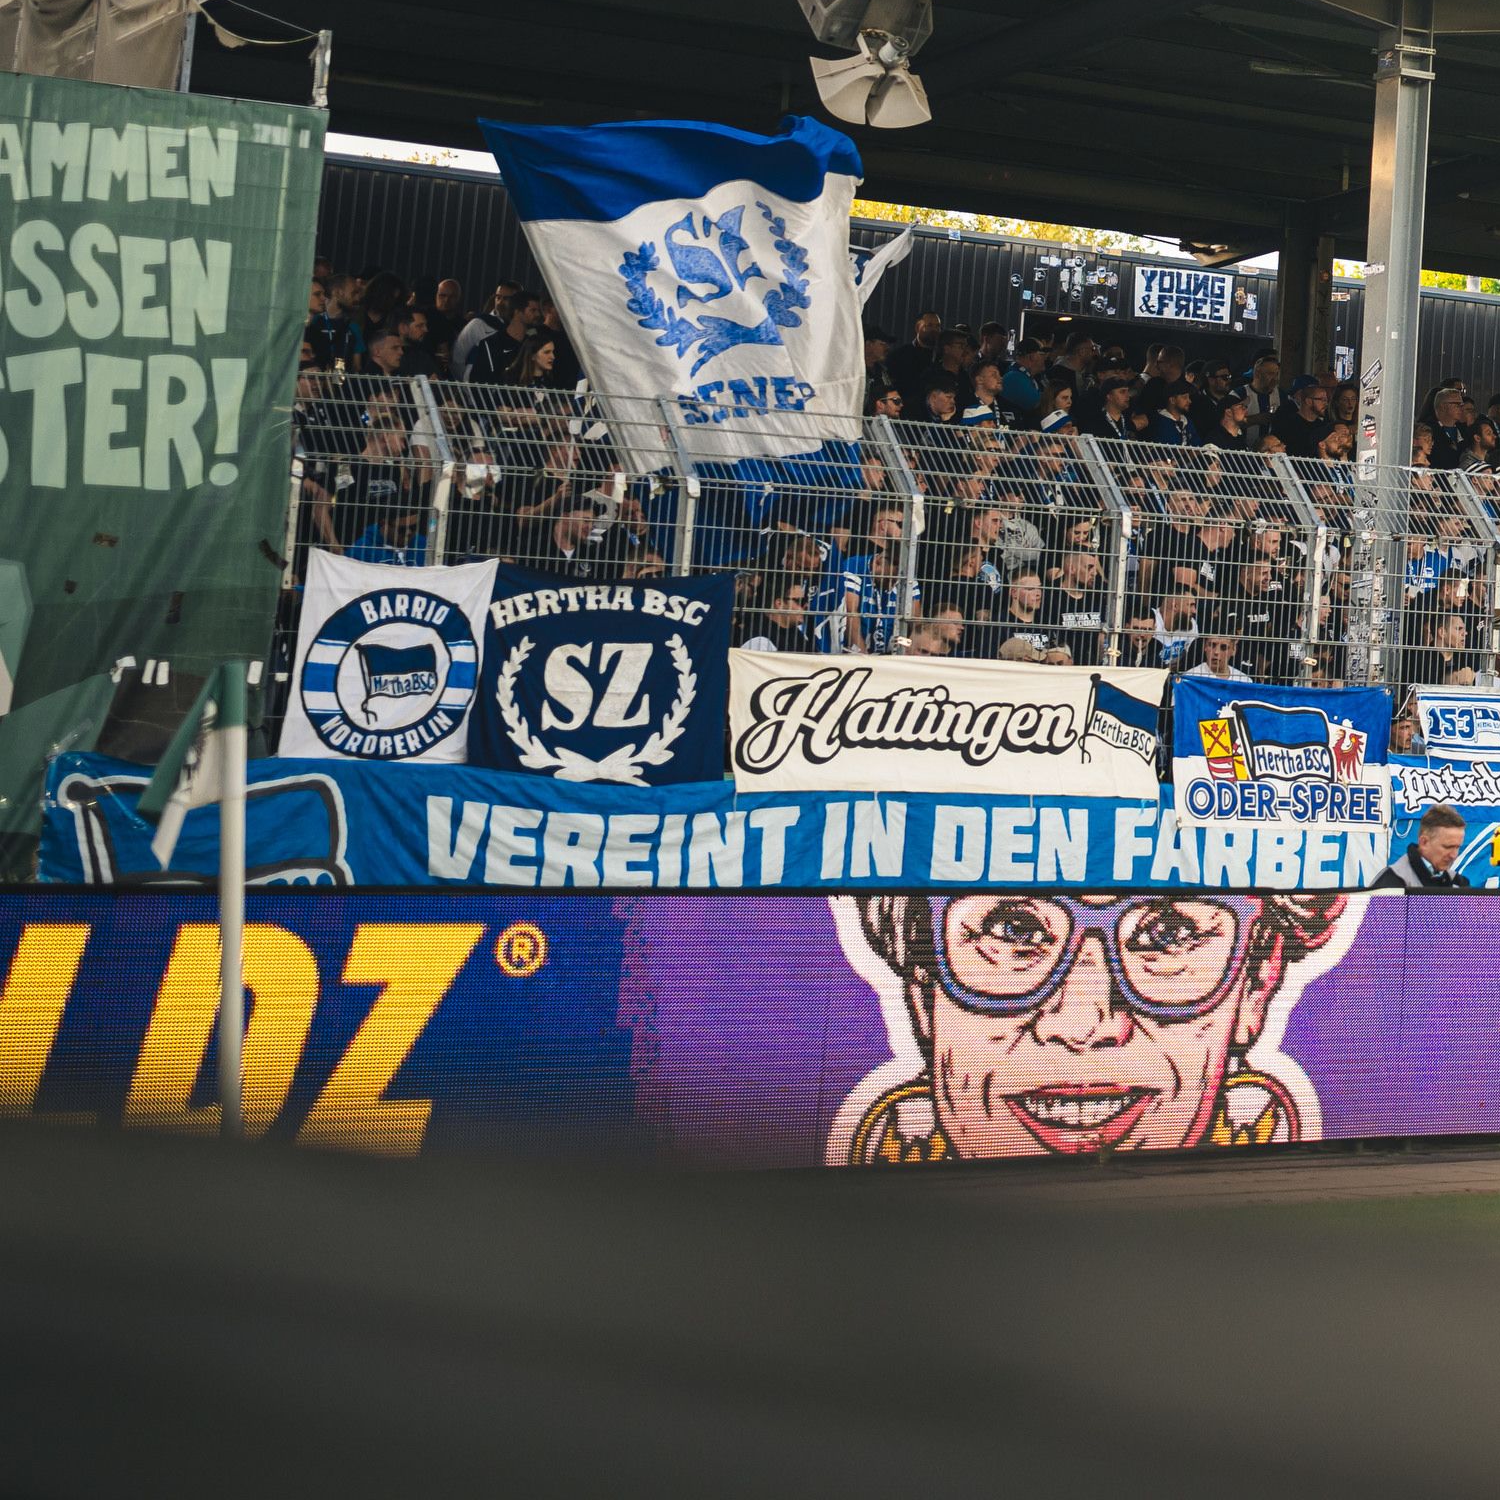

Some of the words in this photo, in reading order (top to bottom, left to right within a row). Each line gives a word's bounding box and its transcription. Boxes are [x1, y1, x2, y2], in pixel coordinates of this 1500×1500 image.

[1140, 268, 1226, 300] YOUNG
[360, 594, 450, 626] BARRIO
[488, 585, 636, 630] HERTHA
[641, 589, 711, 627] BSC
[541, 641, 654, 732] SZ
[320, 710, 454, 757] NORDBERLIN
[738, 667, 1077, 774] Hattingen
[1427, 706, 1477, 740] 153
[1185, 778, 1382, 824] ODER-SPREE
[426, 796, 799, 887] VEREINT
[820, 801, 907, 878] IN
[930, 806, 1088, 882] DEN
[1109, 807, 1388, 888] FARBEN
